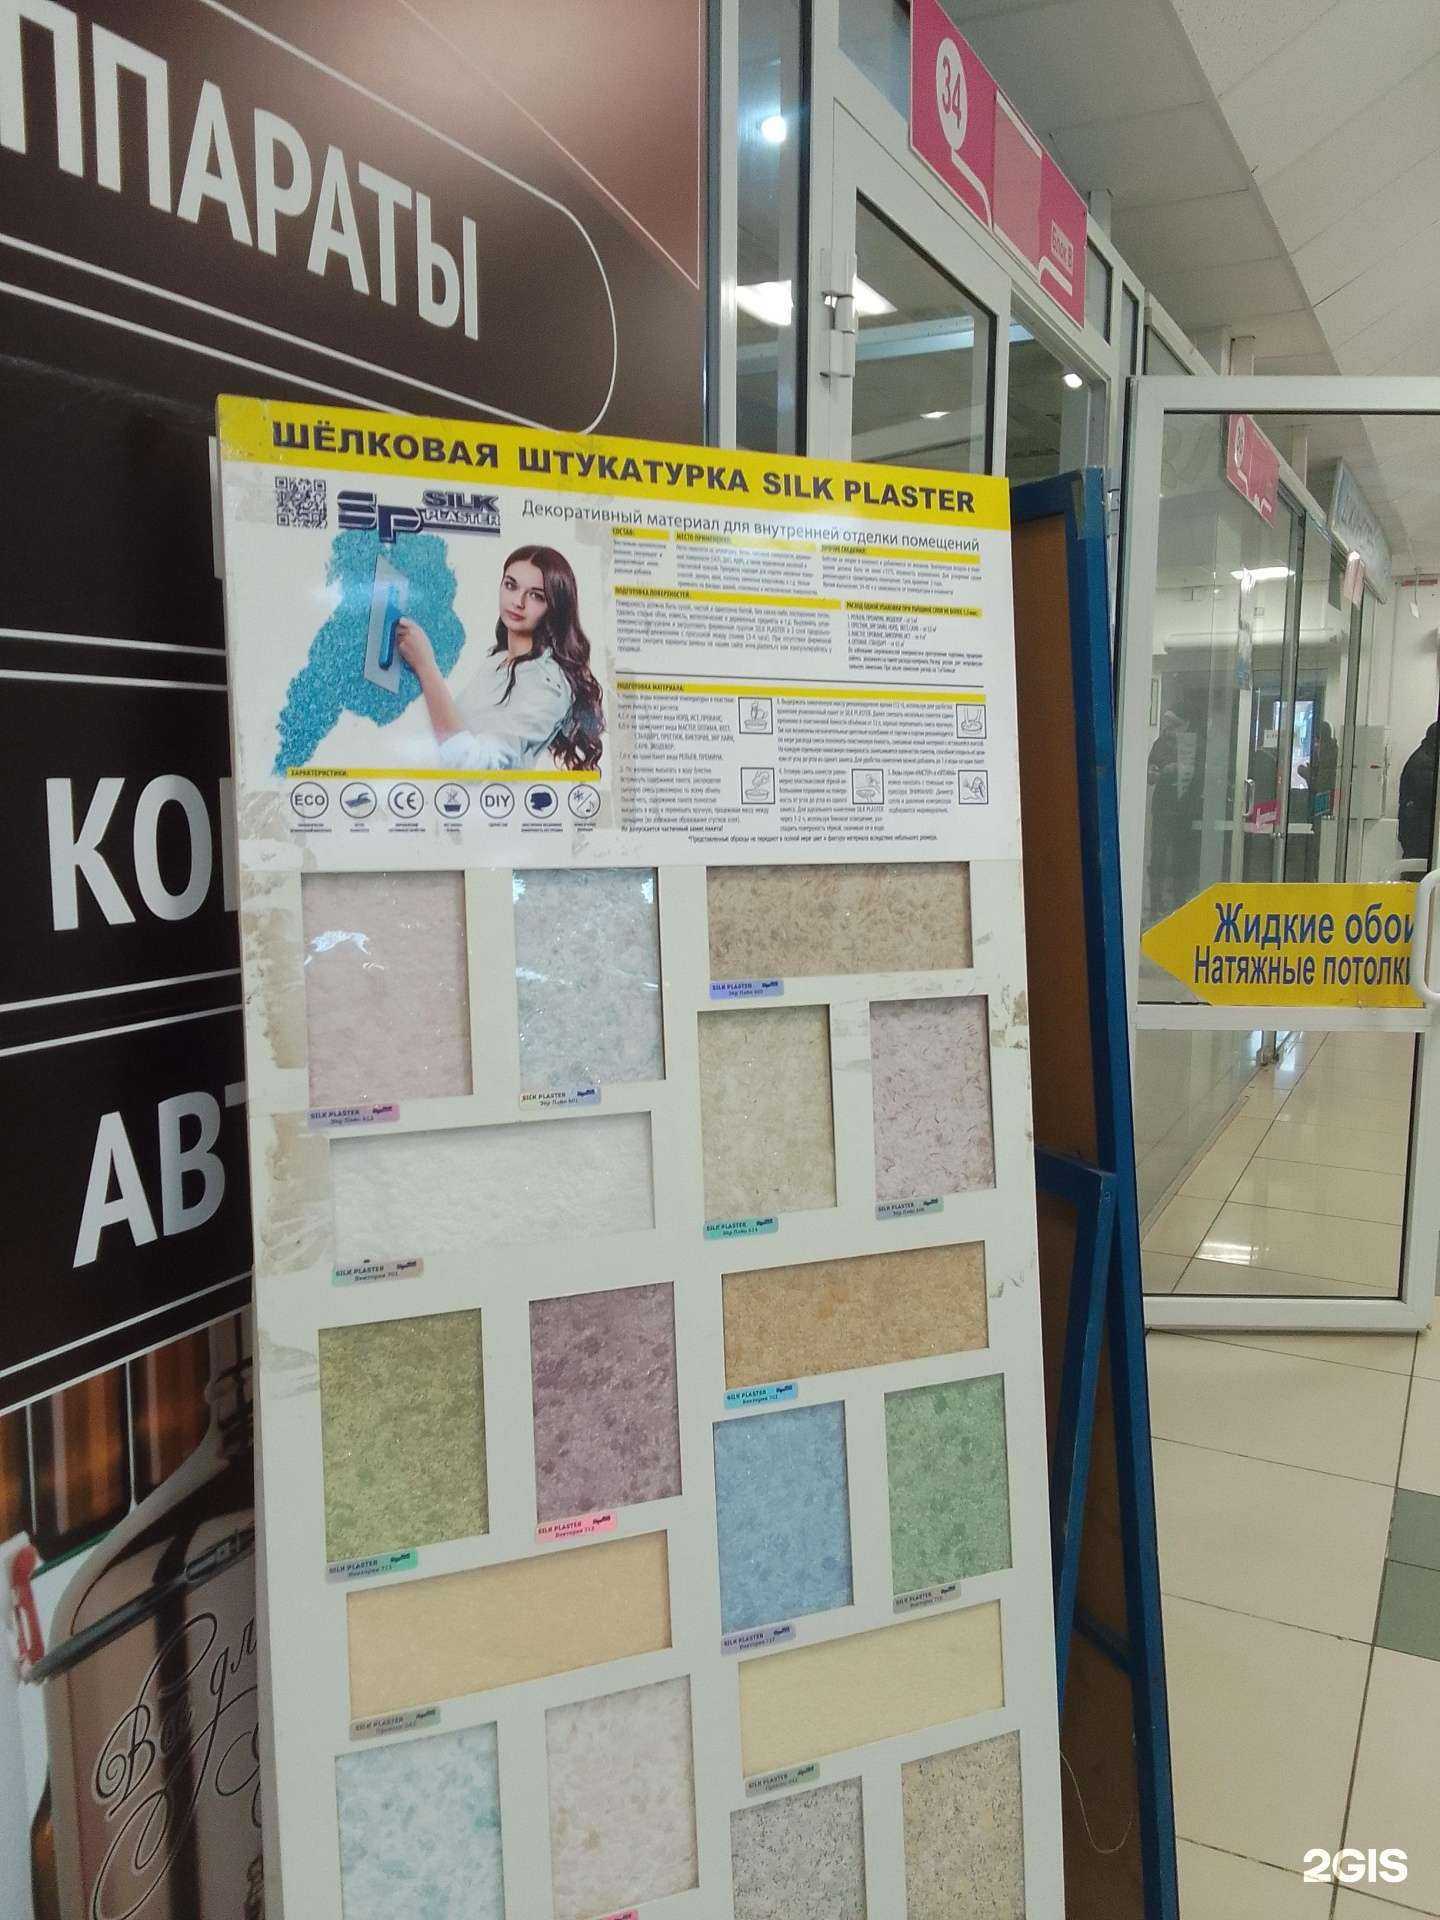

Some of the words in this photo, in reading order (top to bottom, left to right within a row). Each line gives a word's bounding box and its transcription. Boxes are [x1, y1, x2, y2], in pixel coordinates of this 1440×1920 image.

[942, 56, 962, 129] 34
[272, 420, 499, 468] ШЁЛКОВАЯ
[518, 446, 749, 493] ШТУКАТУРКА
[762, 472, 834, 501] SILK
[844, 480, 976, 514] PLASTER
[422, 489, 499, 512] SILK
[422, 508, 500, 527] PLASTER
[521, 500, 643, 526] Декоративный
[647, 513, 720, 531] материал
[724, 522, 750, 534] для
[754, 524, 840, 542] внутренней
[843, 531, 898, 545] отделки
[902, 535, 980, 552] помещений
[294, 794, 325, 806] ECO
[485, 795, 510, 807] DIY
[46, 774, 239, 932] КО
[1214, 902, 1334, 950] Жидкие
[1194, 945, 1315, 985] Натяжные
[73, 1081, 250, 1268] АВ
